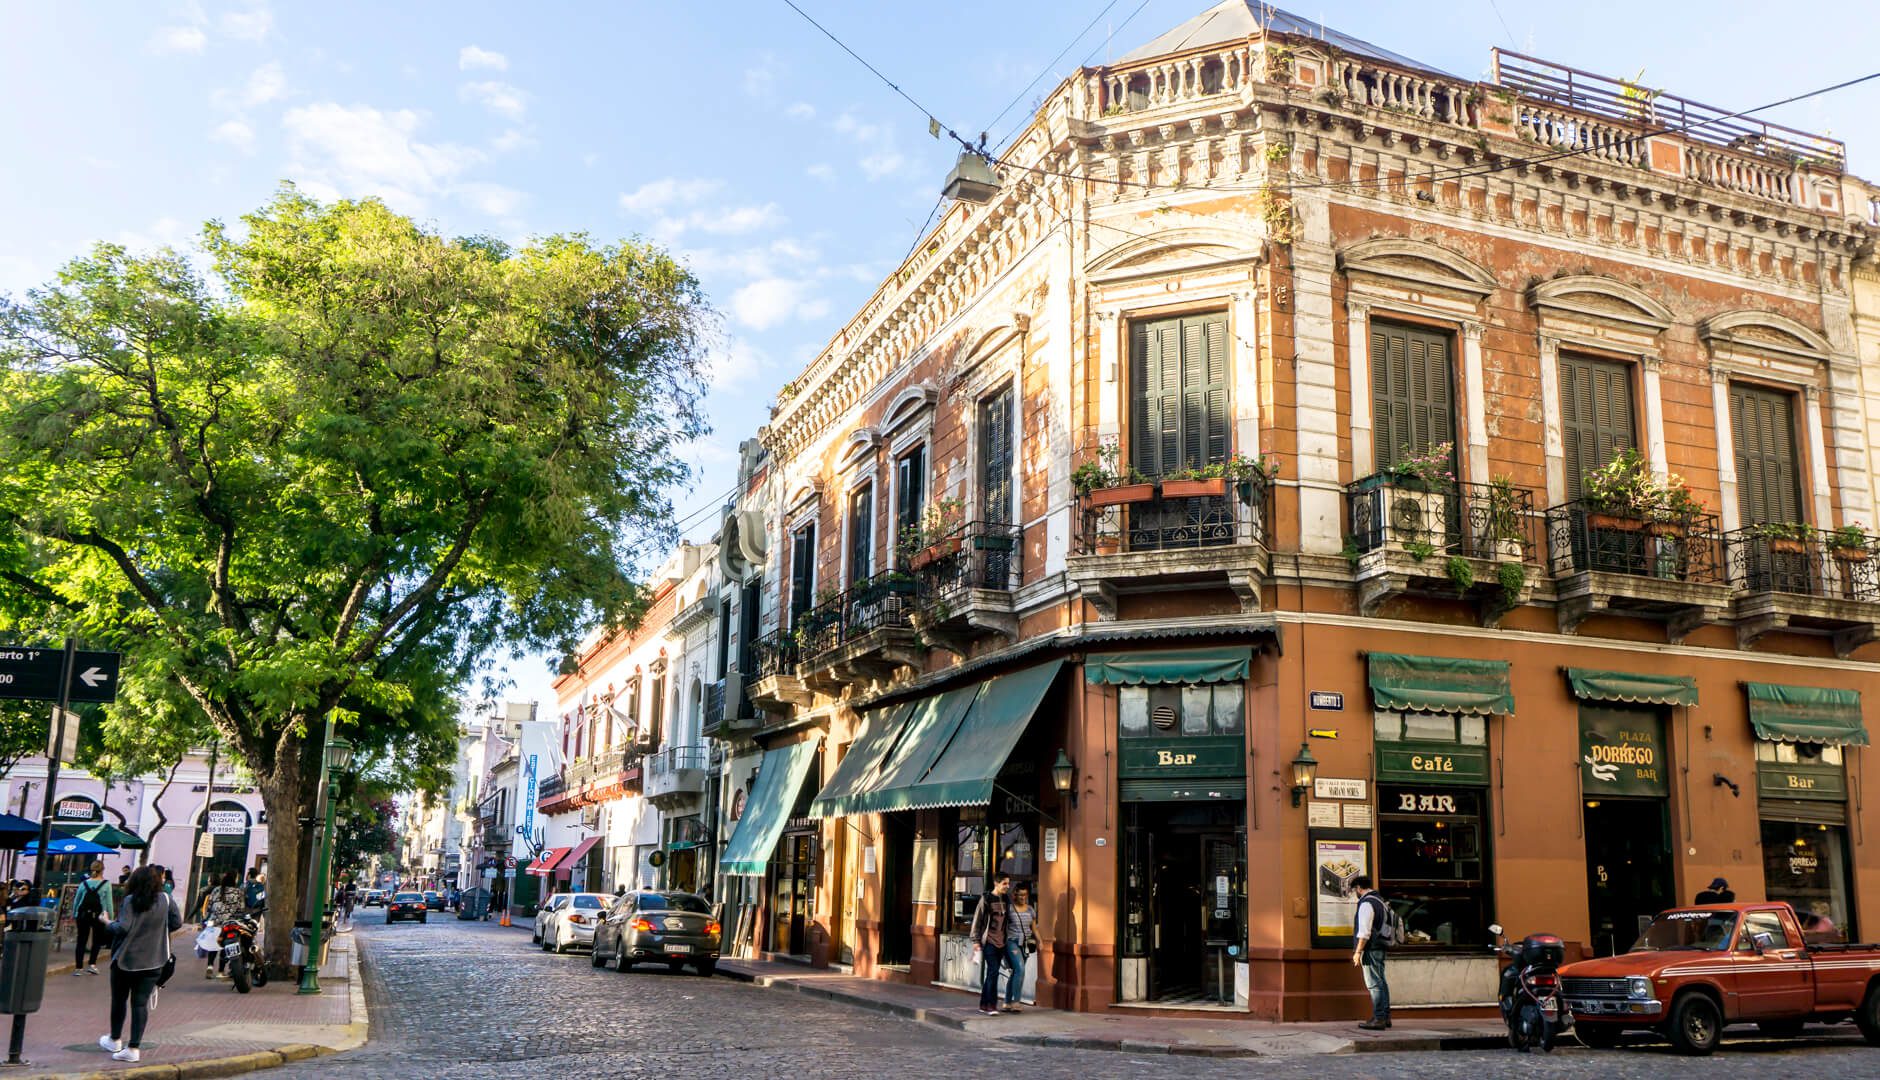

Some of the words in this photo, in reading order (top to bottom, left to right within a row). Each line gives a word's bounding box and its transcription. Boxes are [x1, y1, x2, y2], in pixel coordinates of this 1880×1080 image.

[1620, 731, 1652, 742] PLAZA
[1157, 751, 1197, 766] Bar
[1591, 743, 1653, 765] DORREGO
[1411, 756, 1453, 771] Café
[1636, 769, 1658, 783] BAR
[1787, 775, 1815, 788] Bar
[1398, 794, 1456, 813] BAR
